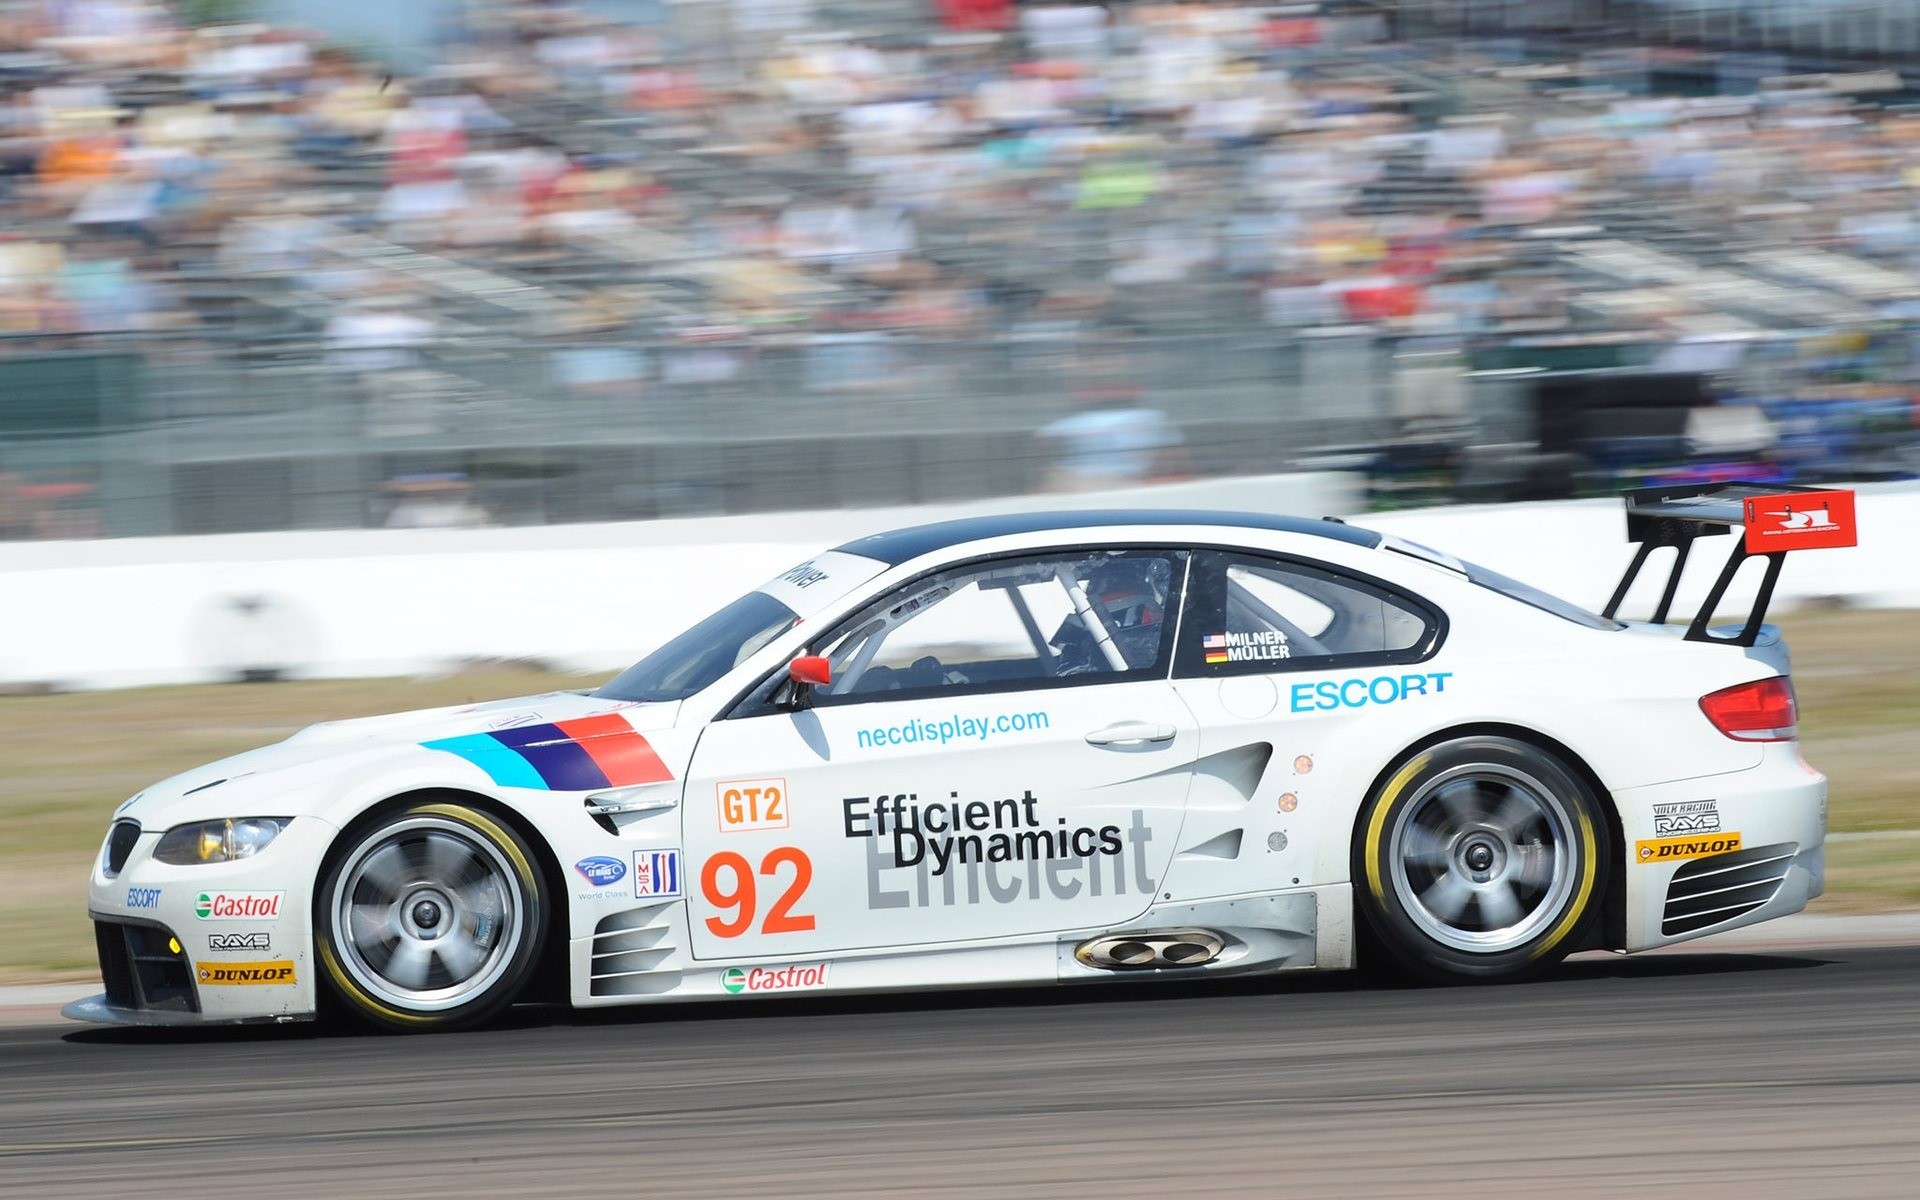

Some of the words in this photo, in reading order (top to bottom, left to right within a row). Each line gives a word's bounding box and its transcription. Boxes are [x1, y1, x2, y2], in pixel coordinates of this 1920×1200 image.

[1226, 632, 1287, 647] MILNER
[1228, 645, 1290, 661] MÜLLER
[1290, 672, 1453, 713] ESCORT
[857, 711, 1049, 748] necdisplay.com
[723, 787, 783, 824] GT2
[843, 790, 1040, 838] Efficient
[1655, 813, 1720, 832] RAYS
[893, 818, 1123, 876] Dynamics
[1657, 839, 1740, 857] DUNLOP
[637, 853, 650, 894] IMSA
[127, 888, 161, 908] ESCORT
[578, 891, 603, 900] World
[605, 889, 628, 898] Class
[700, 846, 816, 938] 92
[213, 894, 280, 917] Castrol
[208, 932, 271, 948] RAYS
[212, 968, 293, 981] DUNLOP
[748, 963, 826, 991] Castrol
